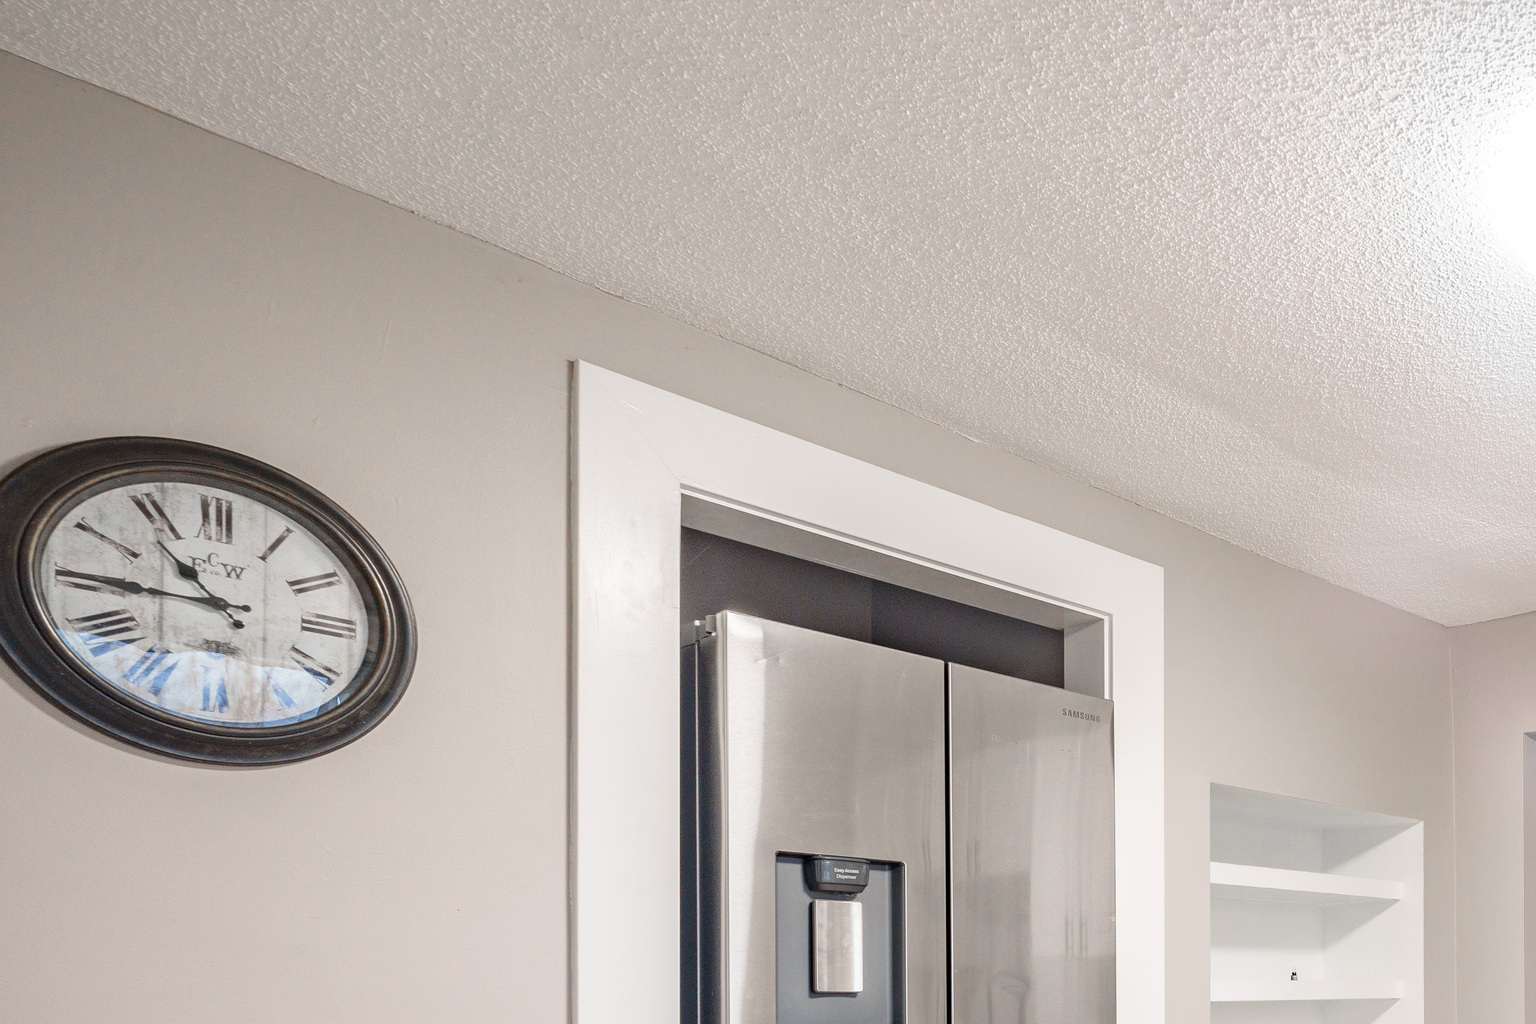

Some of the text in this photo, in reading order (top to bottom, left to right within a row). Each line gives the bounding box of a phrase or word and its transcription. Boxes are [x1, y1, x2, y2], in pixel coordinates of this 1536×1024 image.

[73, 516, 143, 565] X
[193, 492, 236, 547] XII
[256, 525, 295, 564] I
[285, 568, 345, 598] II
[301, 598, 358, 643] III
[1062, 708, 1101, 723] SAMSUNG
